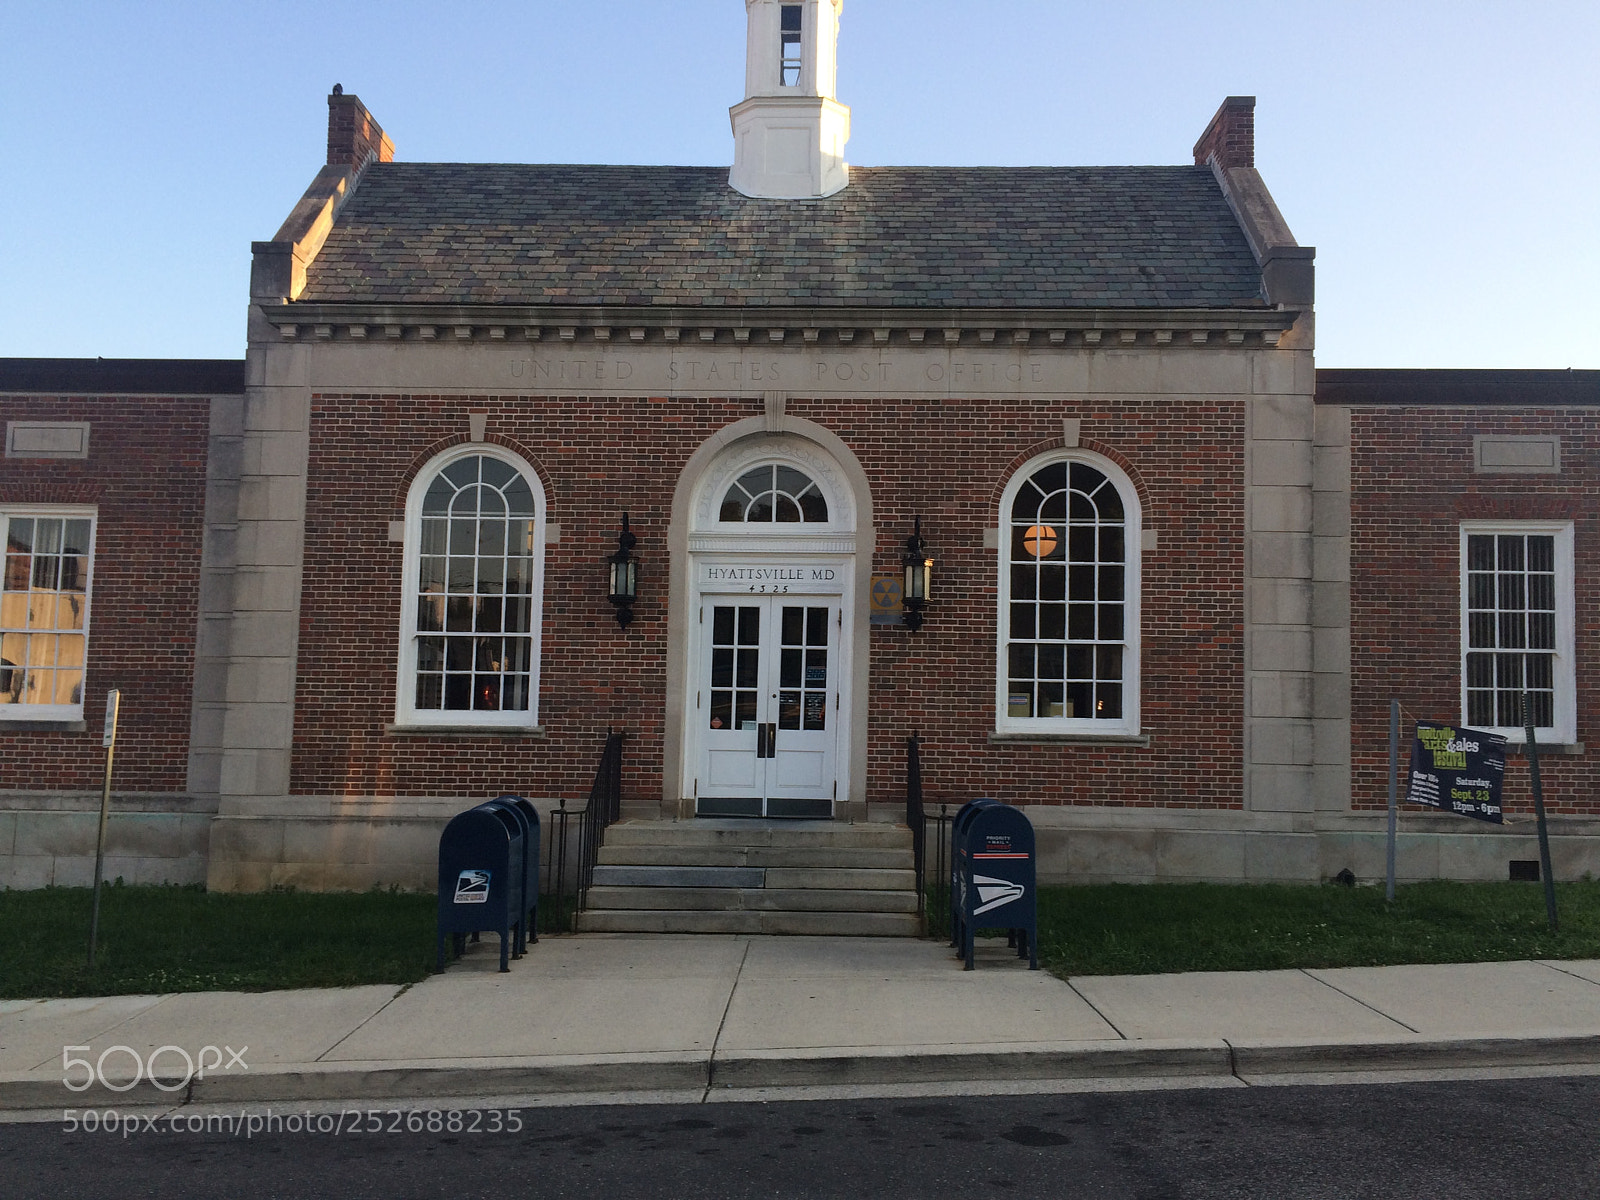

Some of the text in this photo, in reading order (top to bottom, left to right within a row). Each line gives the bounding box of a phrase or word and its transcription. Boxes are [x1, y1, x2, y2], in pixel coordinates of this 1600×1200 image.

[510, 360, 1044, 383] UNITED STATES POST OFFICE
[708, 568, 835, 581] HYATTSVILLE MD
[749, 584, 789, 593] 4325
[1455, 776, 1493, 789] Saturday,
[1450, 788, 1475, 802] Sept.
[1475, 790, 1490, 801] 23
[1452, 801, 1476, 814] 12pm
[1480, 803, 1501, 815] 6pm
